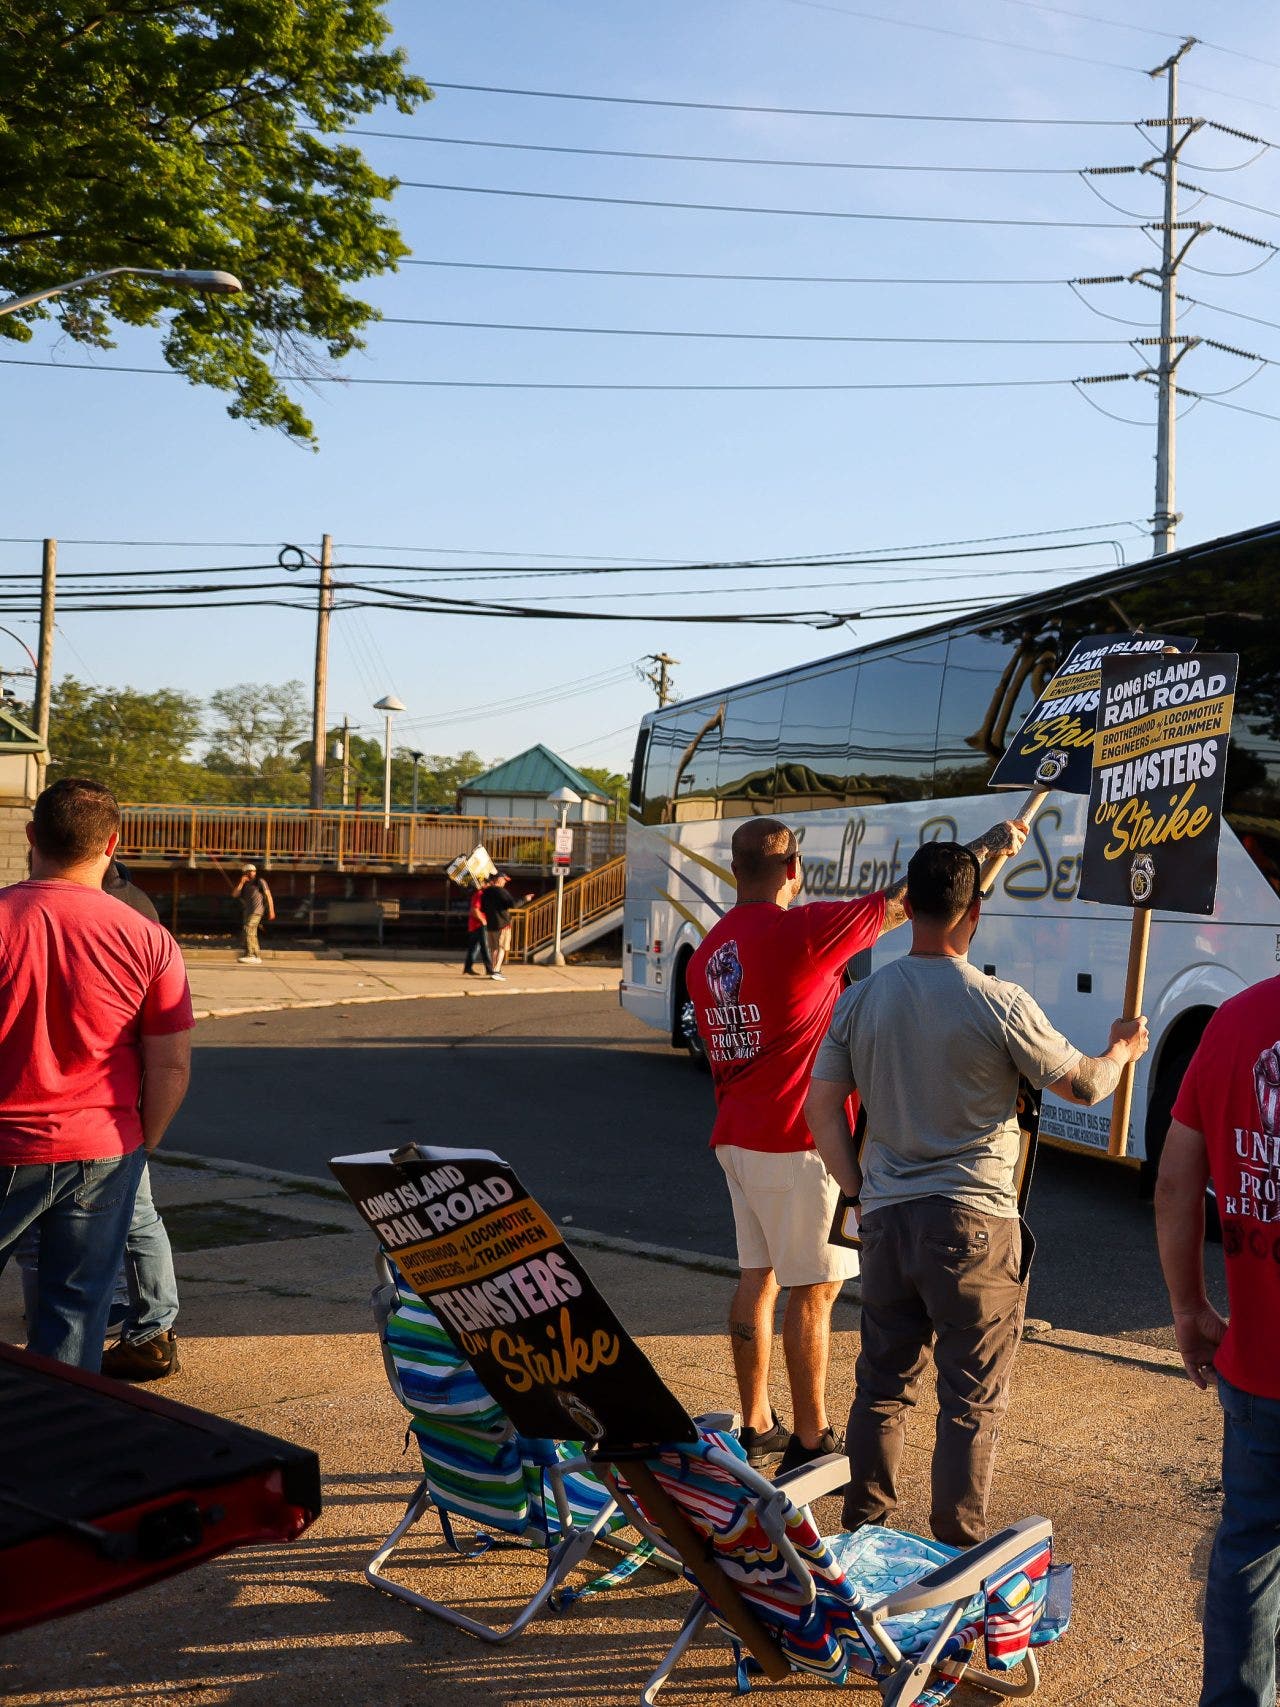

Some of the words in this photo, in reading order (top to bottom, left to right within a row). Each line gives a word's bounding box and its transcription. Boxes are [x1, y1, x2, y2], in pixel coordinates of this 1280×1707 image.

[1071, 646, 1109, 664] LONG
[1108, 639, 1165, 655] ISLAND
[1034, 689, 1101, 723] TEAMS
[1104, 695, 1149, 727] RAIL
[1152, 674, 1227, 710] ROAD
[1106, 677, 1141, 705] LONG
[1143, 660, 1200, 691] ISLAND
[1101, 735, 1150, 760] ENGINEERS
[1162, 716, 1222, 741] TRAINMEN
[1102, 719, 1156, 746] BROTHERHOOD
[1163, 701, 1225, 726] LOCOMOTIVE
[1100, 739, 1218, 804] TEAMSTERS
[1095, 801, 1118, 825] On
[1104, 783, 1213, 861] Strike
[705, 1004, 760, 1025] UNITED
[711, 1031, 762, 1049] PROTECT
[360, 1190, 402, 1221] LONG
[398, 1165, 465, 1209] ISLAND
[376, 1212, 434, 1249] RAIL
[424, 1176, 514, 1232] ROAD
[1225, 1195, 1272, 1224] REAL
[400, 1242, 459, 1270] BROTHERHOOD
[466, 1207, 536, 1249] LOCOMOTIVE
[411, 1261, 466, 1286] ENGINEERS
[477, 1224, 548, 1266] TRAINMEN
[429, 1251, 584, 1335] TEAMSTERS
[460, 1330, 488, 1356] On
[490, 1307, 620, 1393] Strike
